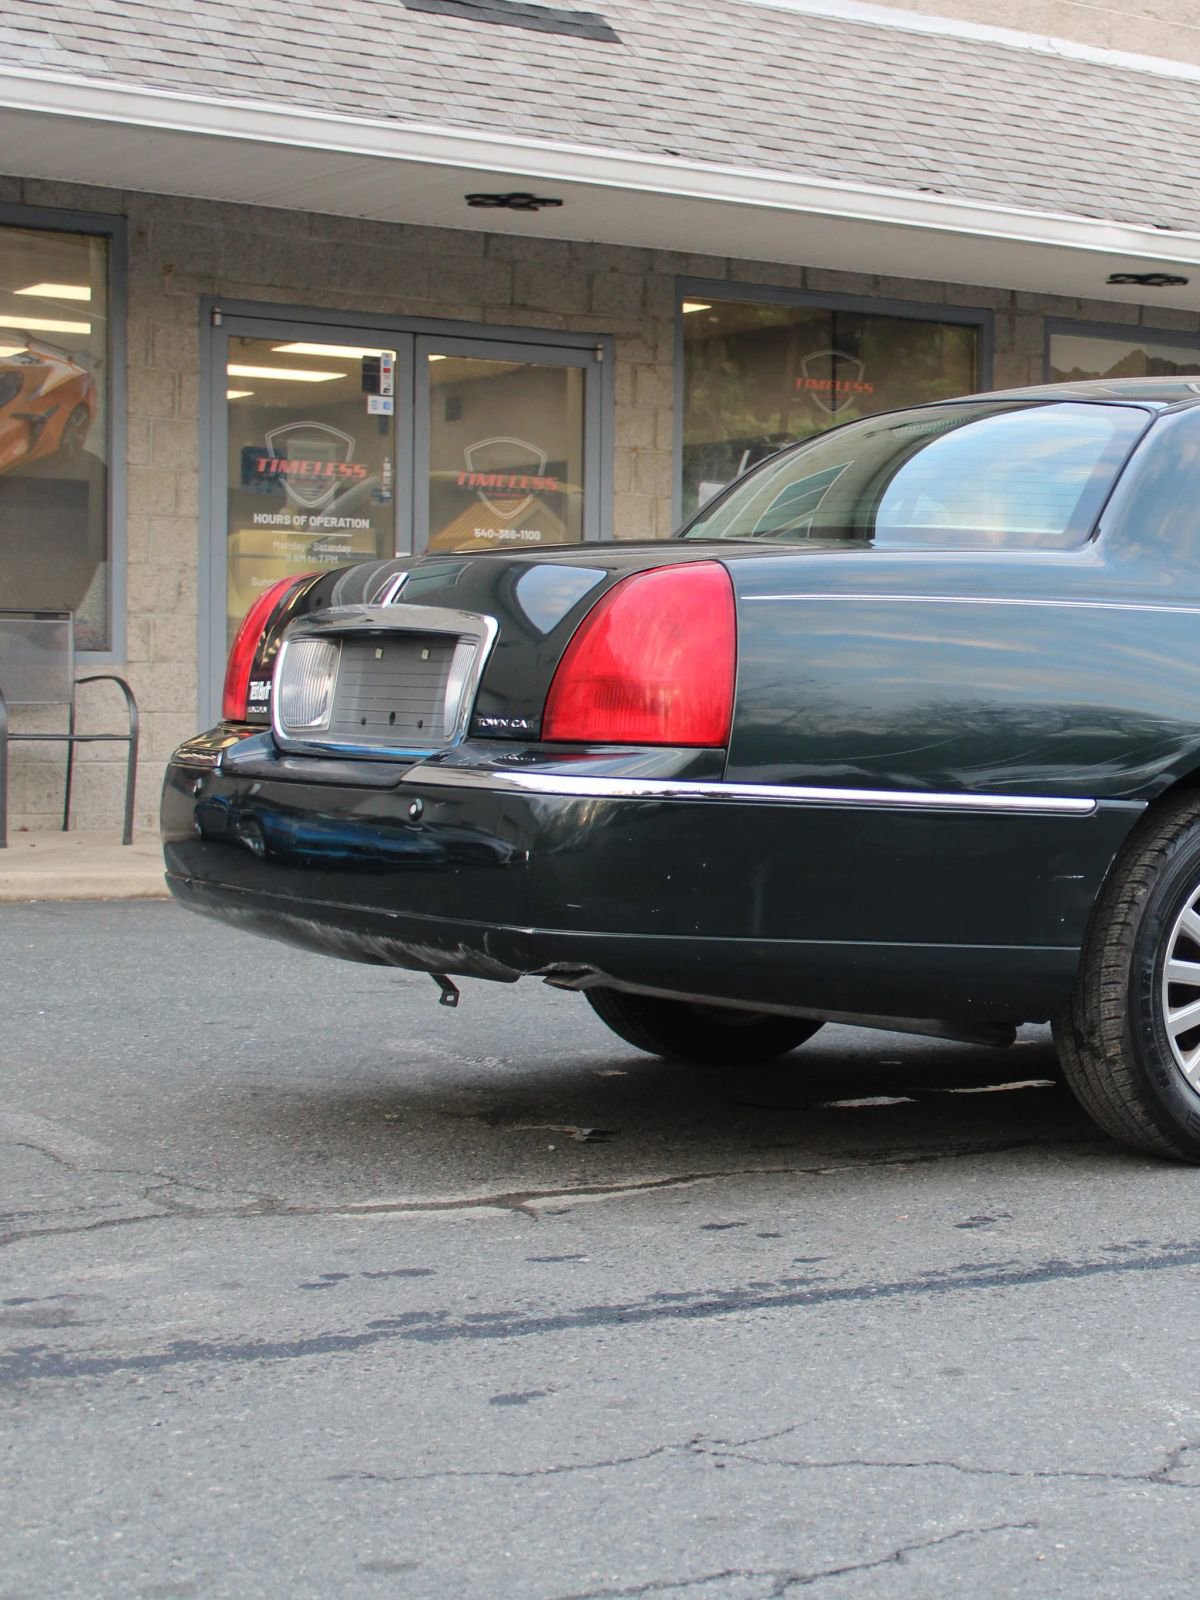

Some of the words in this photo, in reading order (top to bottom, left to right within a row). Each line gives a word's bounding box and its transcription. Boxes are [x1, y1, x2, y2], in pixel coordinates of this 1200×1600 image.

[256, 457, 368, 478] TIMELESS
[457, 471, 558, 490] TIMELESS
[253, 513, 291, 525] HOURS
[294, 515, 308, 526] OF
[309, 516, 370, 529] OPERATION
[272, 541, 306, 553] Monday
[312, 542, 352, 555] Saturday
[307, 555, 317, 564] to
[325, 555, 339, 564] PM
[476, 718, 509, 728] TOWN
[511, 719, 535, 728] CAR
